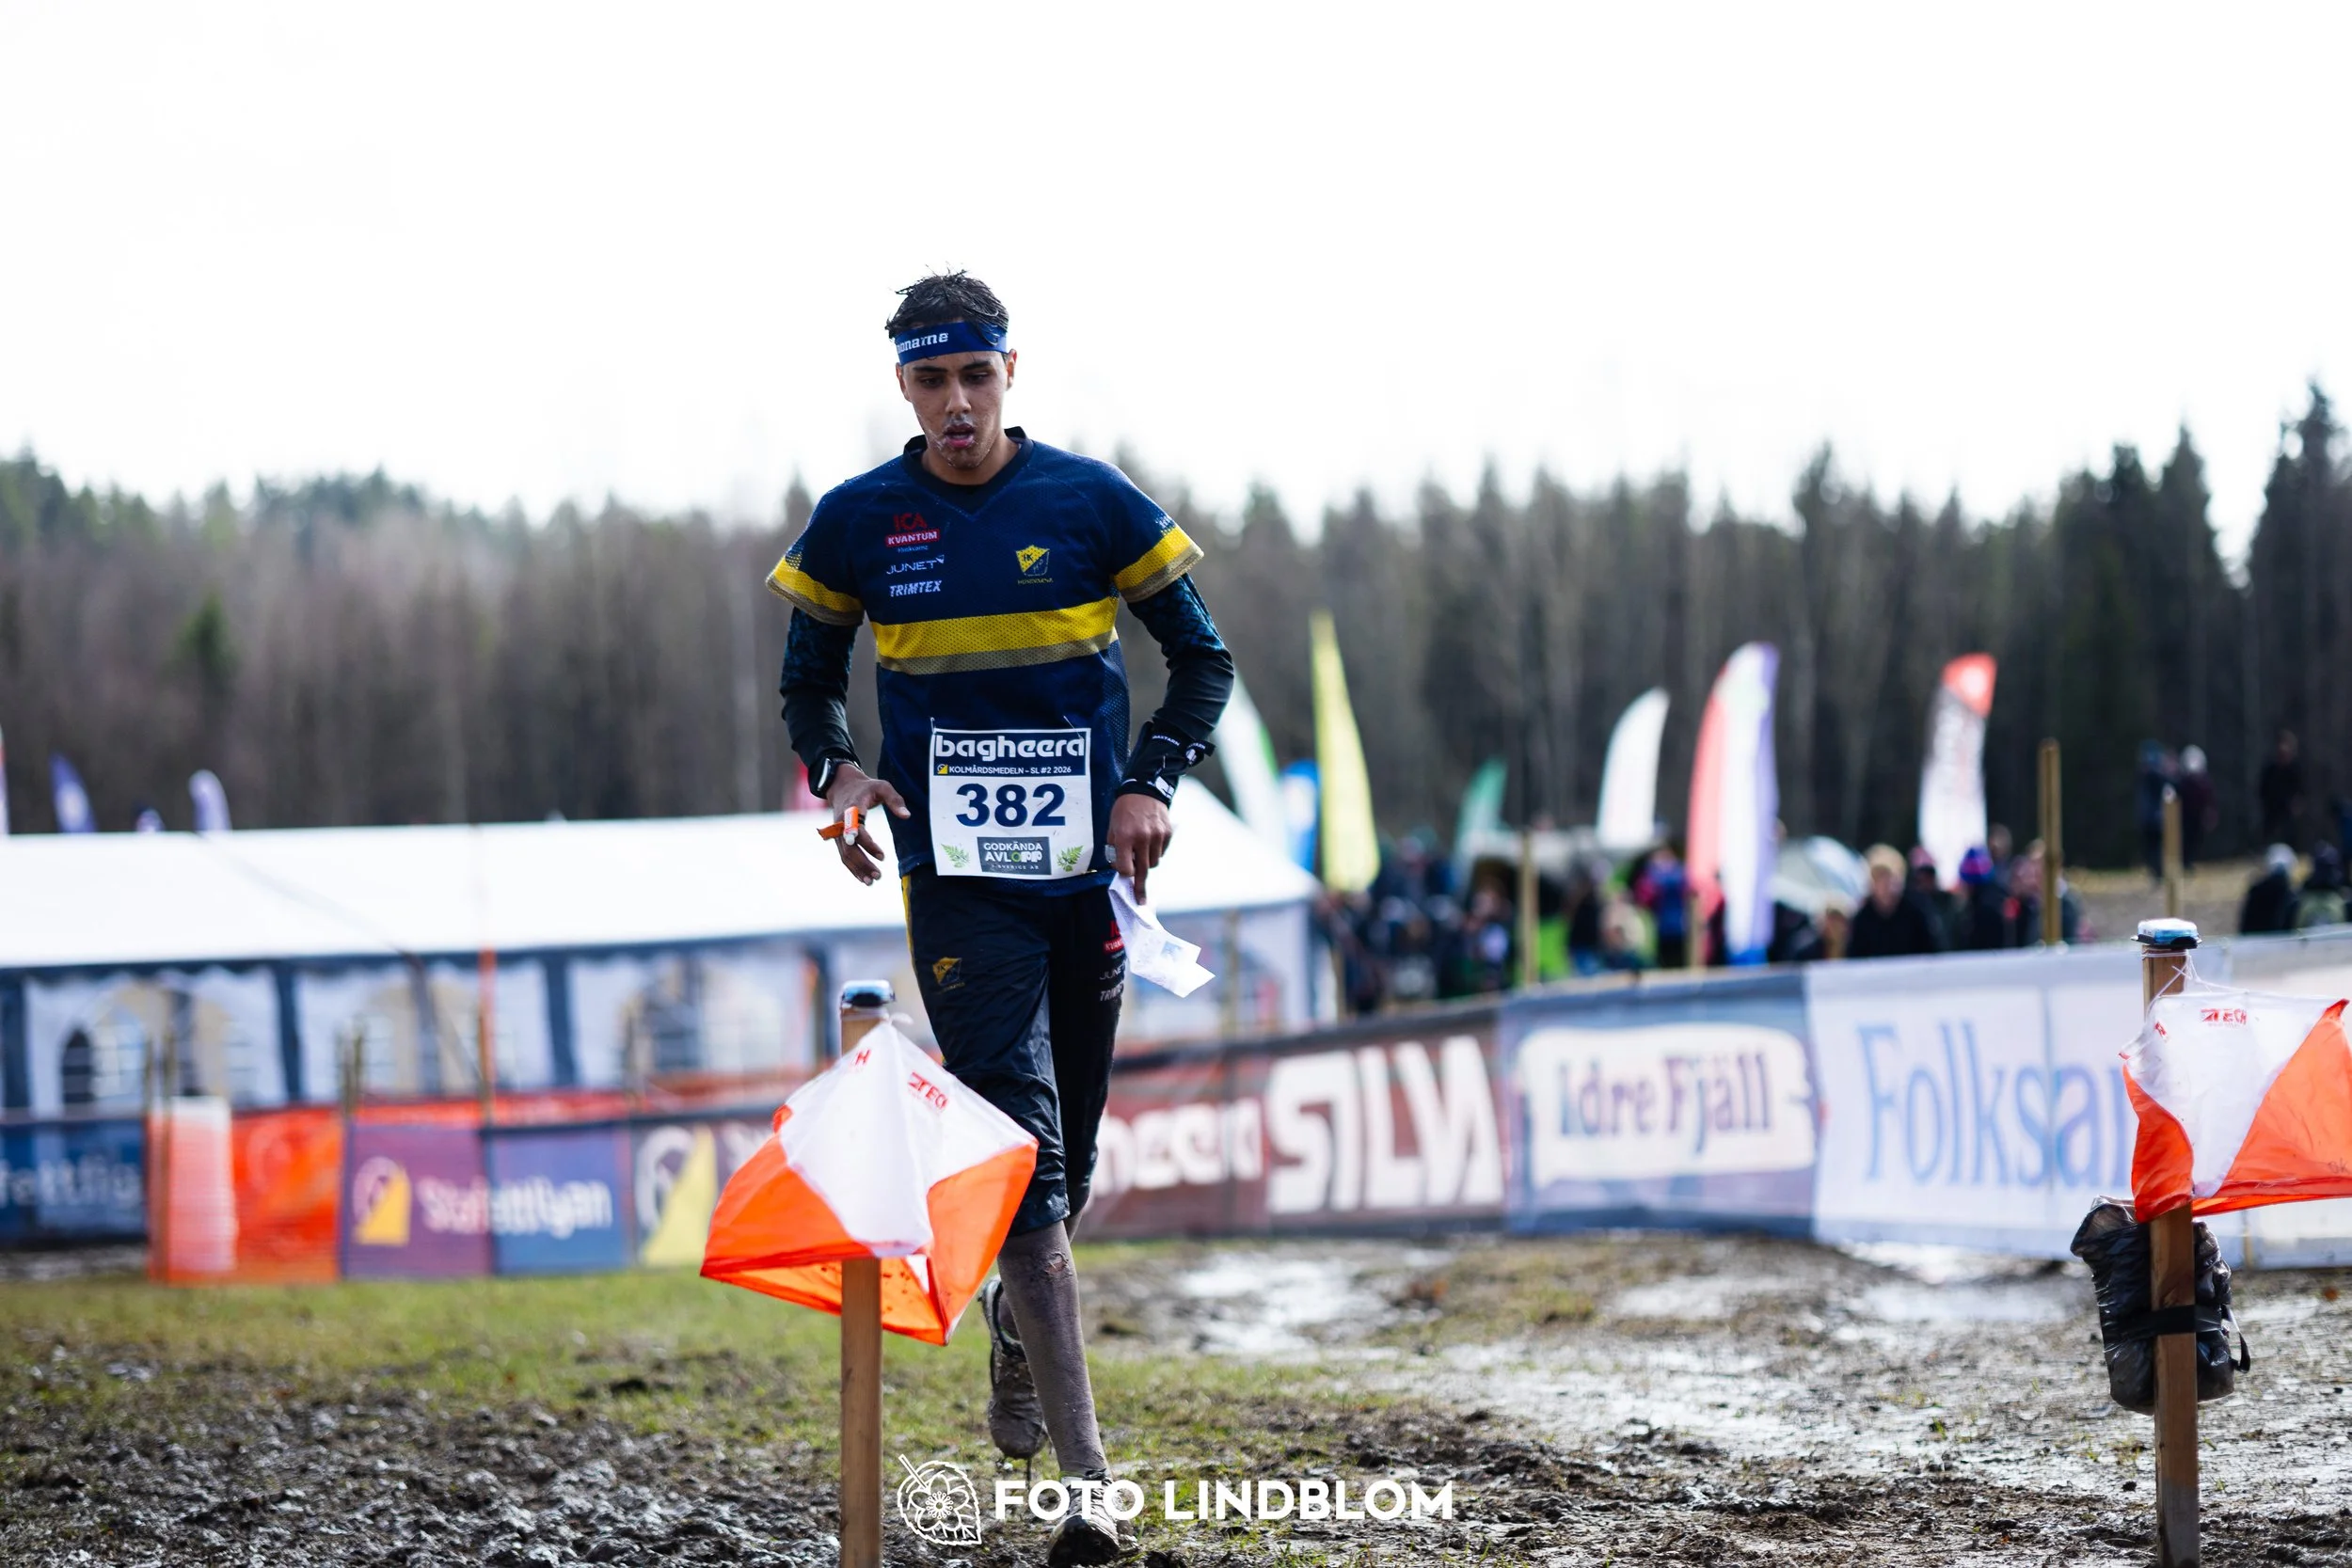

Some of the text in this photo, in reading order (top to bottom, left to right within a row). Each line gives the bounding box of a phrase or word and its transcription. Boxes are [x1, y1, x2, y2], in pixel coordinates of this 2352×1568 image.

[893, 513, 928, 531] ICA
[888, 531, 938, 545] KVANTUM
[889, 580, 942, 597] TRIMTEX
[935, 735, 1086, 762] bagheera
[948, 765, 1025, 774] KOLMÅRDSMEDELN
[955, 784, 1066, 827] 382
[983, 841, 1043, 850] GODKÄNDA
[985, 851, 1043, 863] AVLOPP
[1558, 1057, 1659, 1136] Idre
[1266, 1034, 1503, 1213] SILVA
